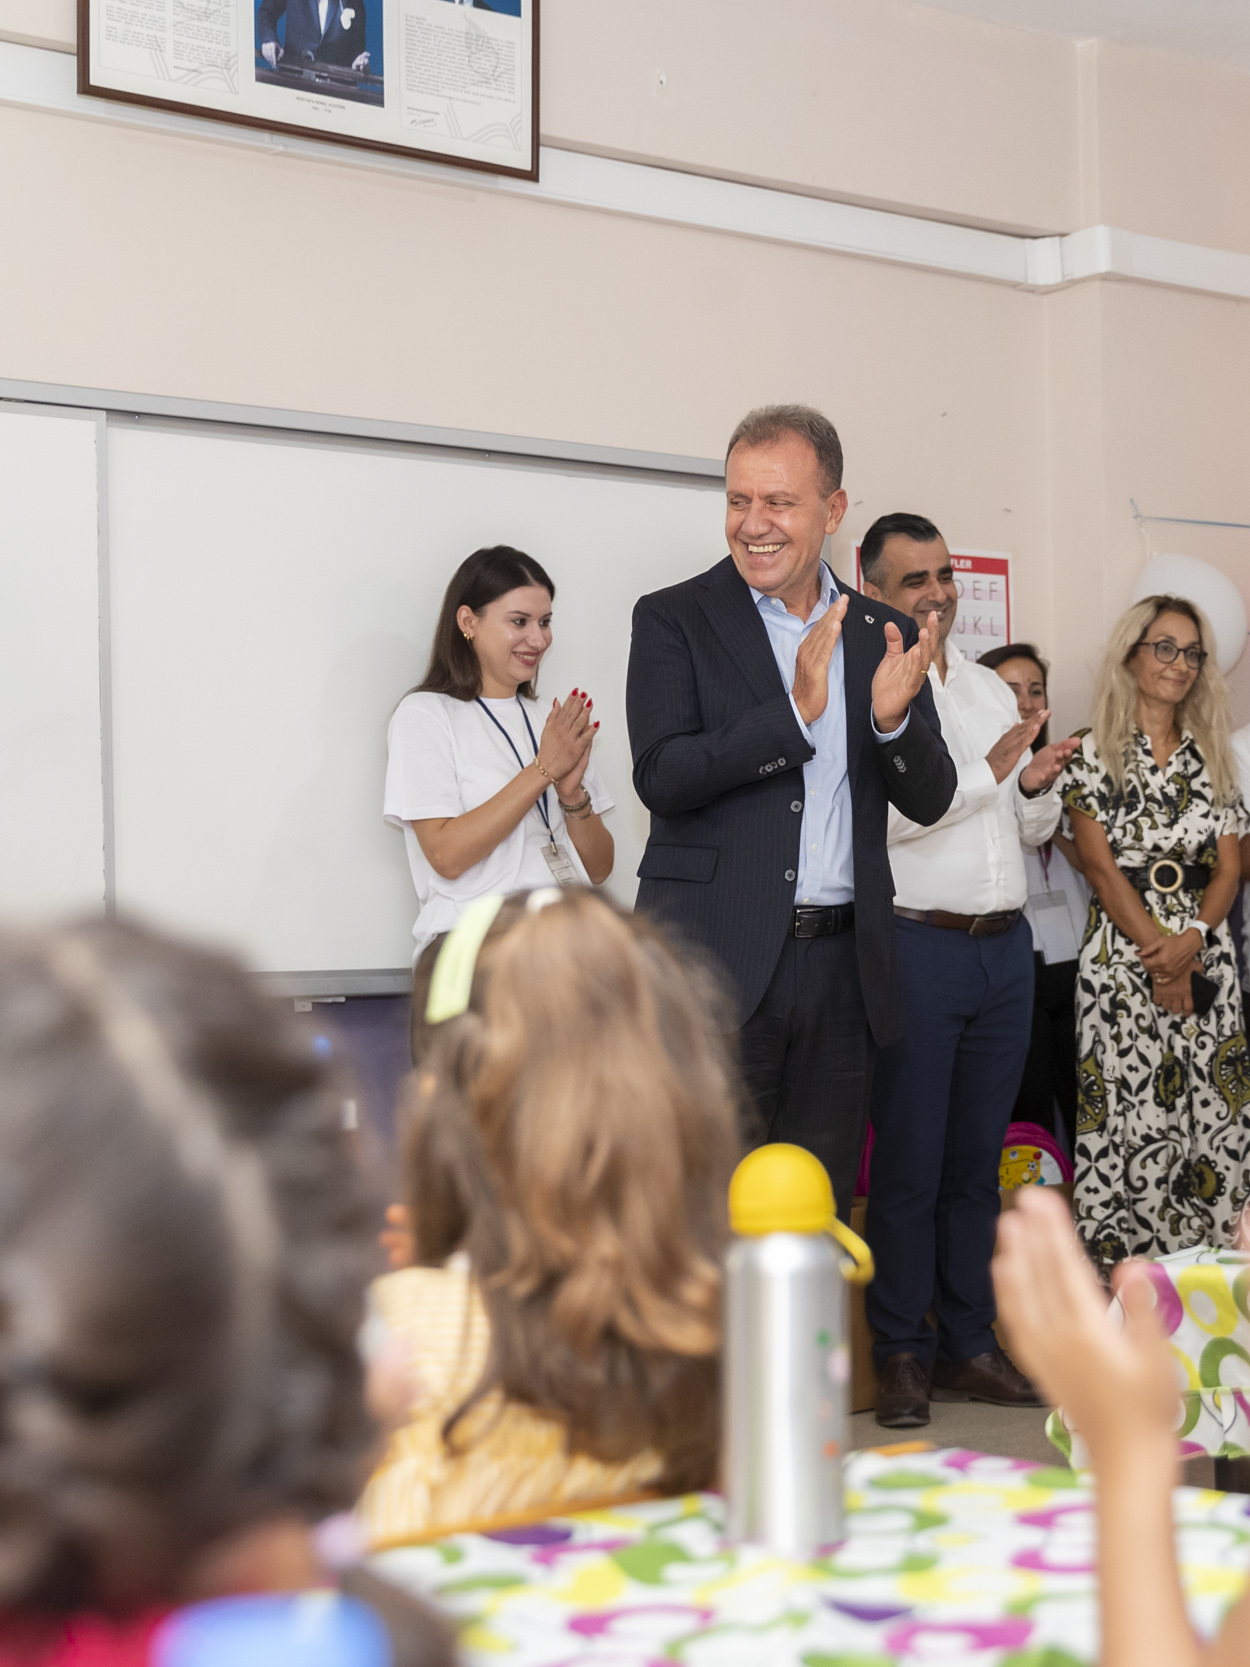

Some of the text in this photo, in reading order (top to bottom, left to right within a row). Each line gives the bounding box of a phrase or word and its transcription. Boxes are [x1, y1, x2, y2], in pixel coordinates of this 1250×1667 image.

[951, 558, 972, 569] FLER
[973, 580, 981, 600] E
[989, 581, 998, 601] F
[956, 615, 999, 636] J K L
